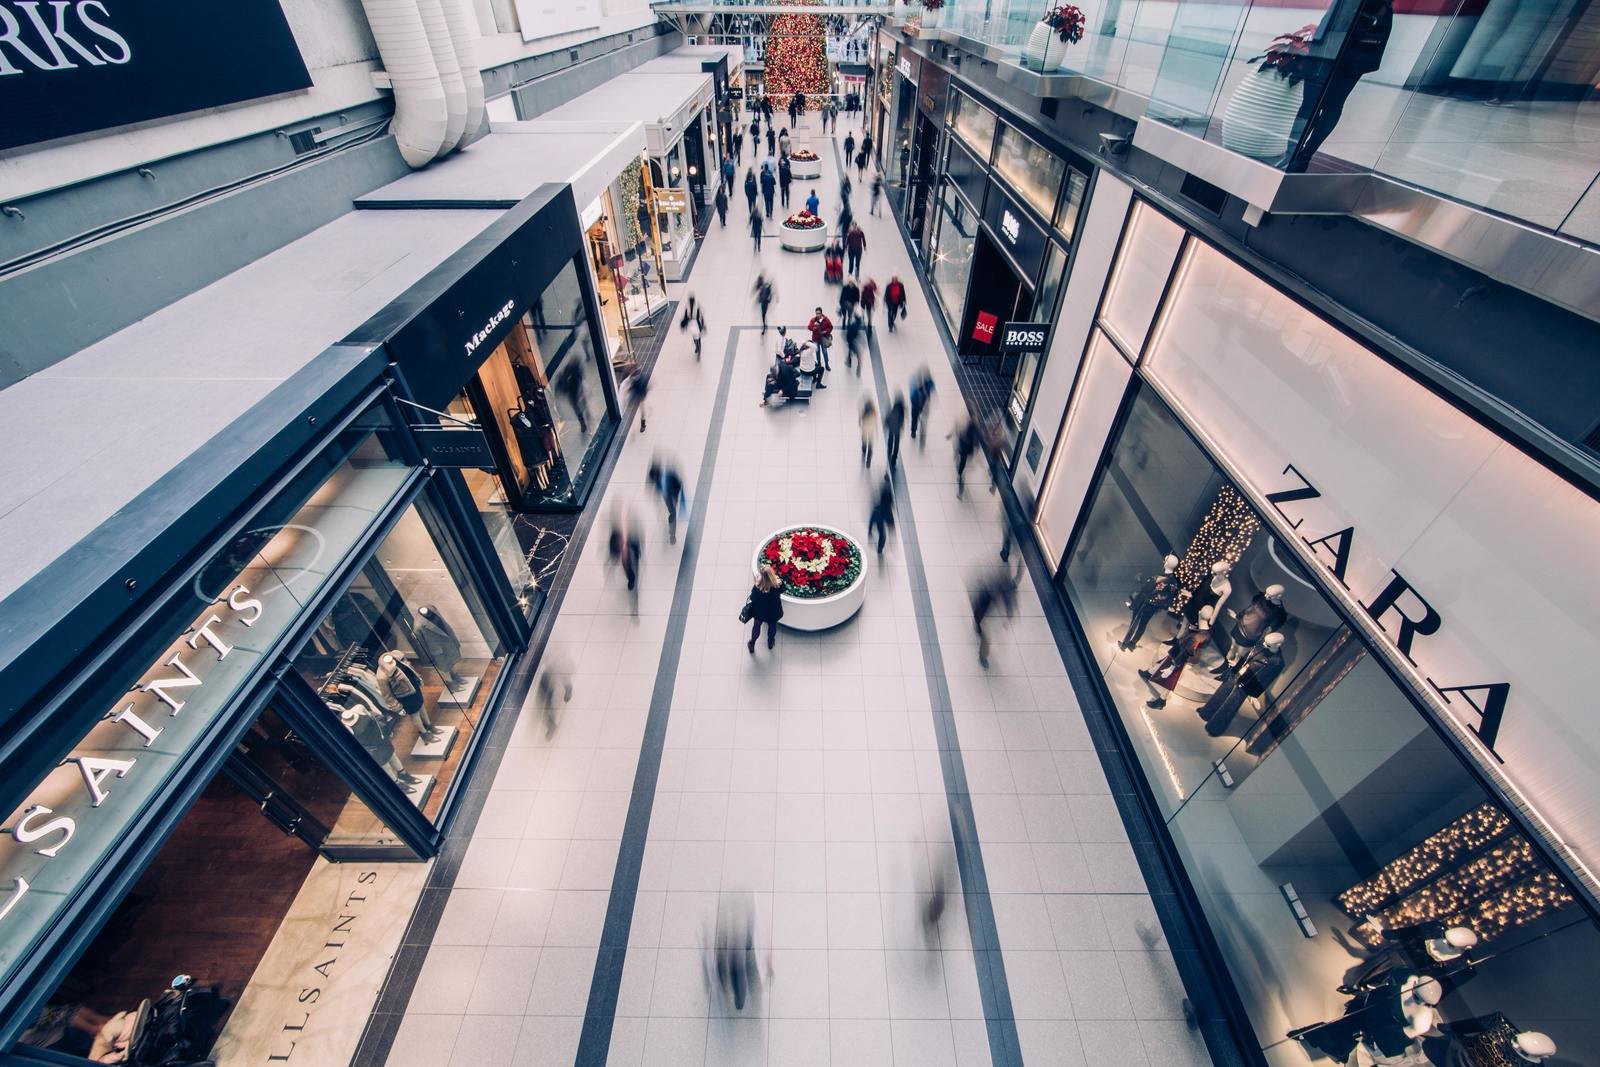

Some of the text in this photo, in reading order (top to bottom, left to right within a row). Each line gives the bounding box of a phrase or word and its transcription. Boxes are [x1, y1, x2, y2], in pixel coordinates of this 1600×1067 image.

[464, 299, 515, 356] Mackage
[975, 321, 994, 334] SALE
[1006, 330, 1045, 343] BOSS
[1265, 463, 1511, 765] ZARA
[267, 870, 378, 1064] LLSAINTS
